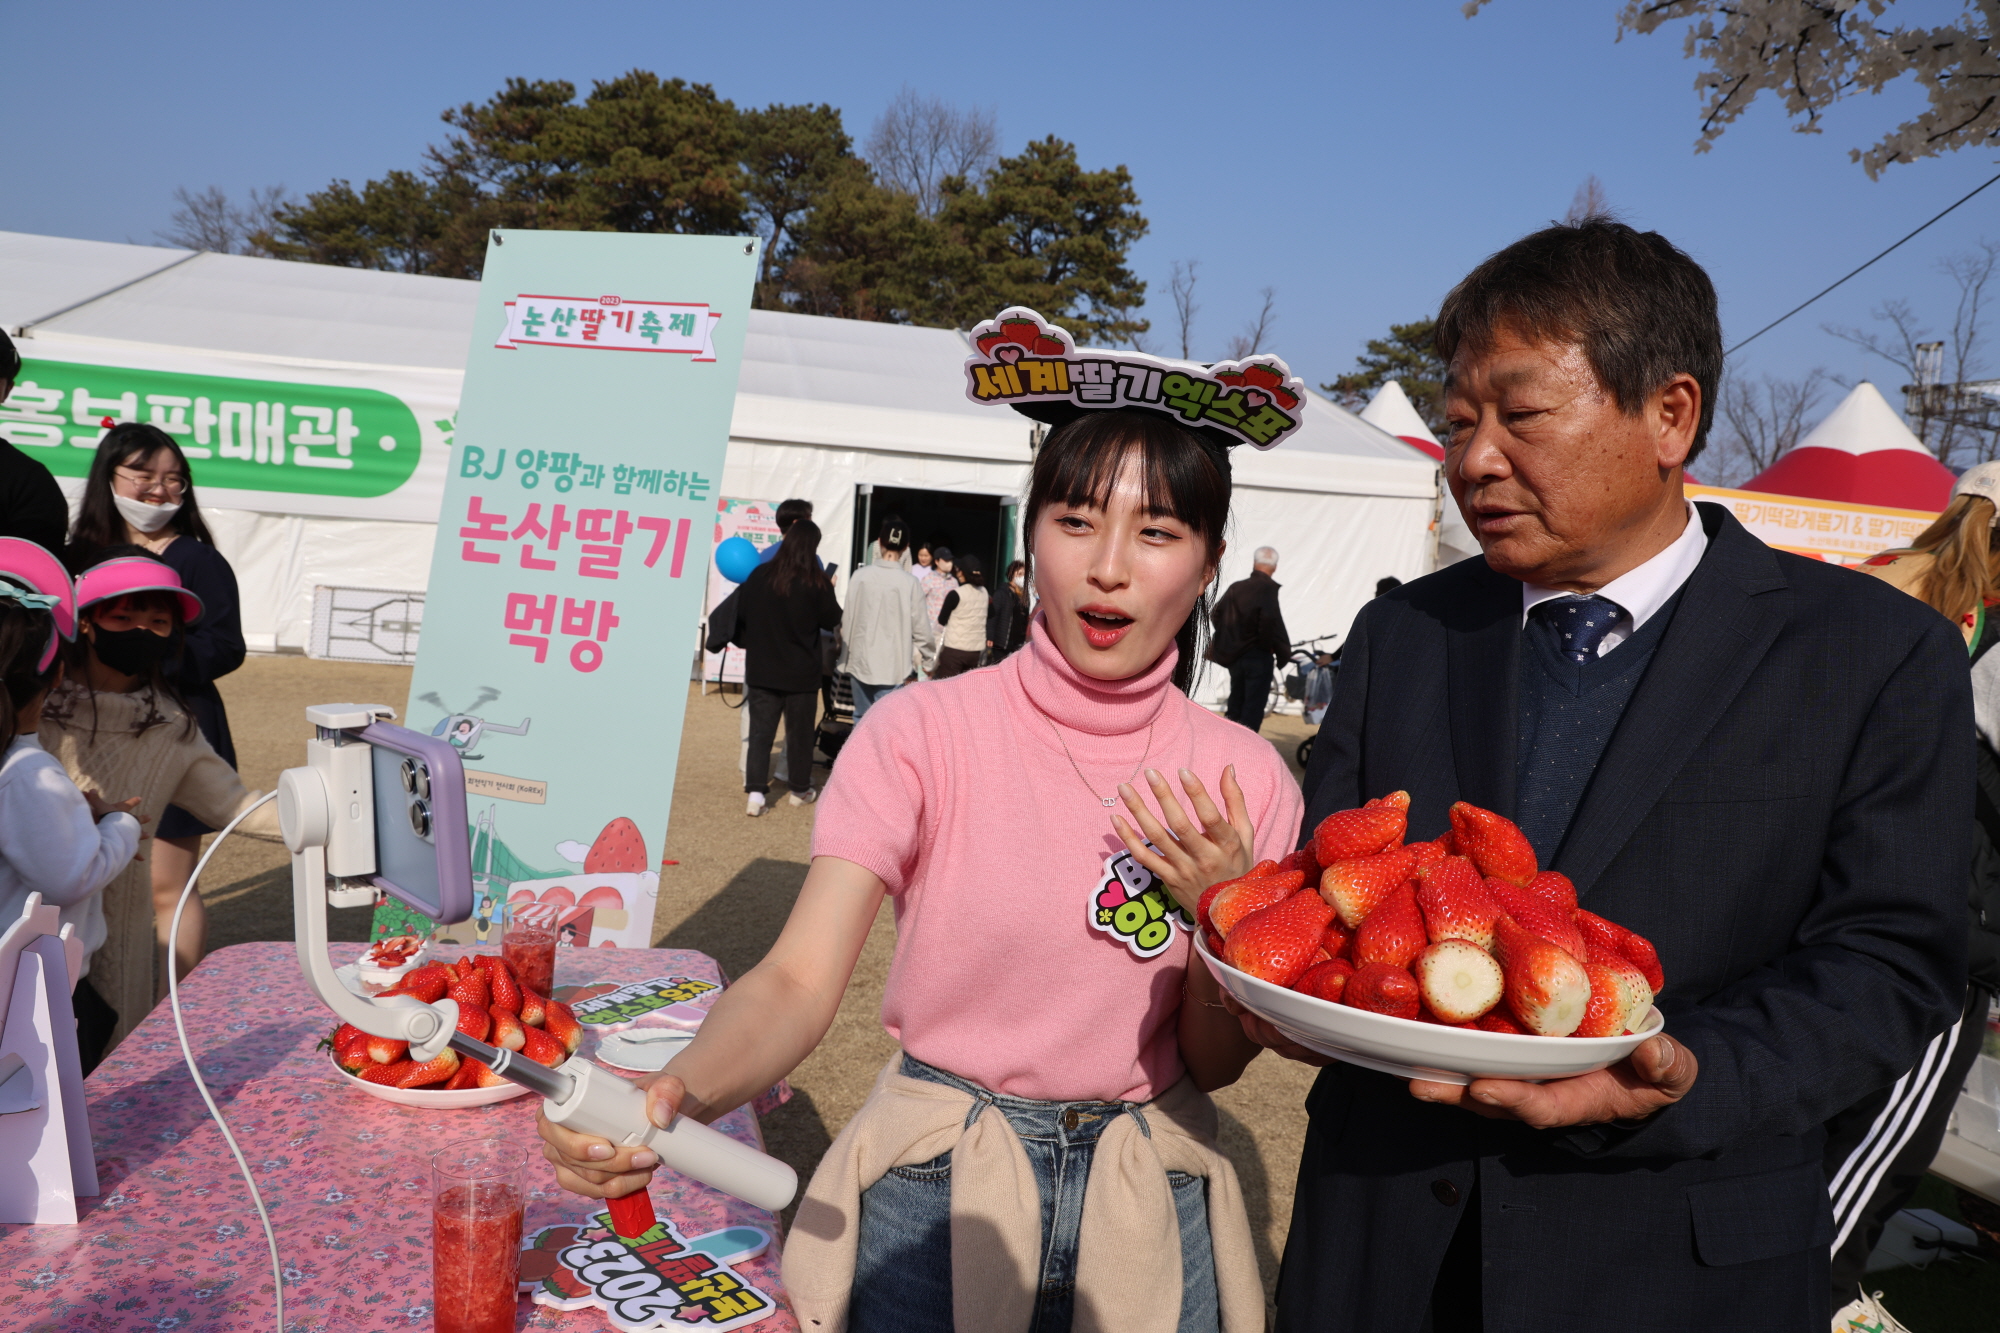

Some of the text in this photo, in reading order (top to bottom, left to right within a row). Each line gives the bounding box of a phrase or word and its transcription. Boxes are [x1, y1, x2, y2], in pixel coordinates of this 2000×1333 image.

[521, 306, 697, 345] 논산딸기축제
[601, 296, 620, 305] 2023
[0, 380, 361, 470] 홍보판매관
[460, 444, 711, 501] BJ 양팡과 함께하는
[458, 496, 692, 580] 논산딸기
[1852, 515, 1863, 536] &
[503, 592, 621, 673] 먹방
[495, 781, 516, 791] 전시회
[564, 1242, 685, 1323] 2023
